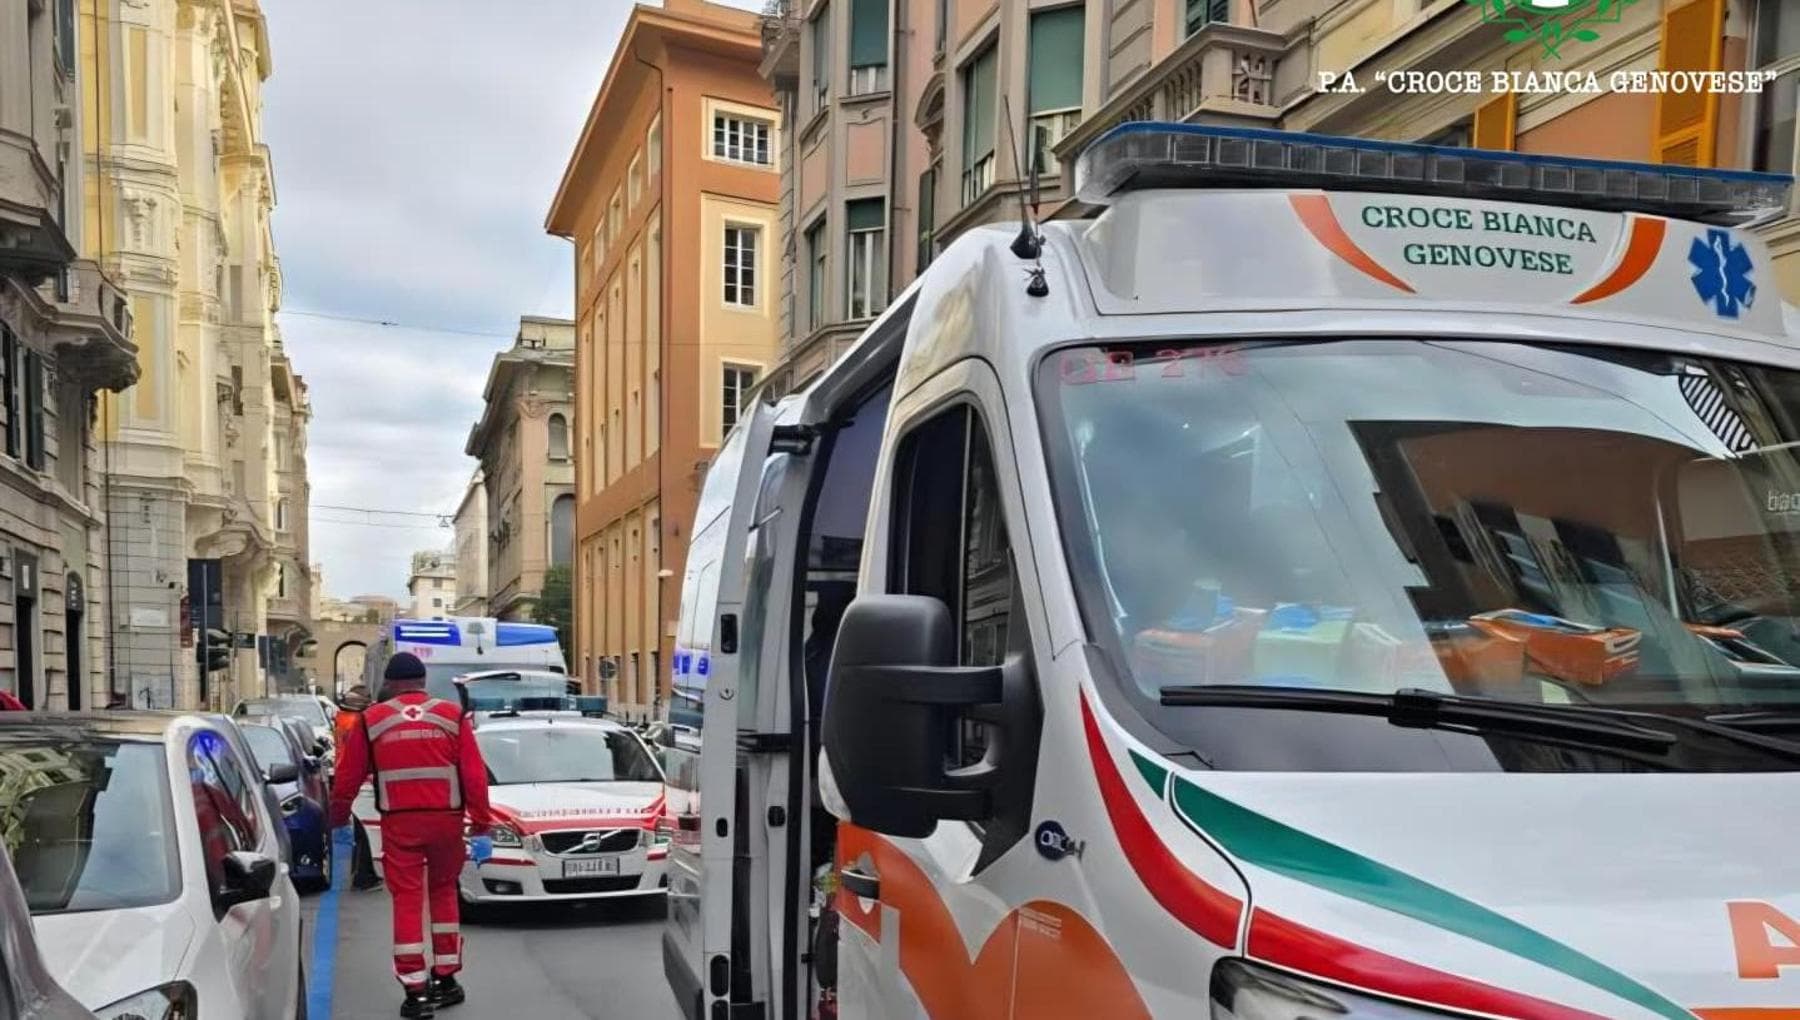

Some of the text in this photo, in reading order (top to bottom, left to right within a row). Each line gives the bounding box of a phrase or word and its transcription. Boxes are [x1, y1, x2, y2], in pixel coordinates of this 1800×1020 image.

[1361, 206, 1597, 243] CROCE BIANCA
[1403, 243, 1573, 275] GENOVESE
